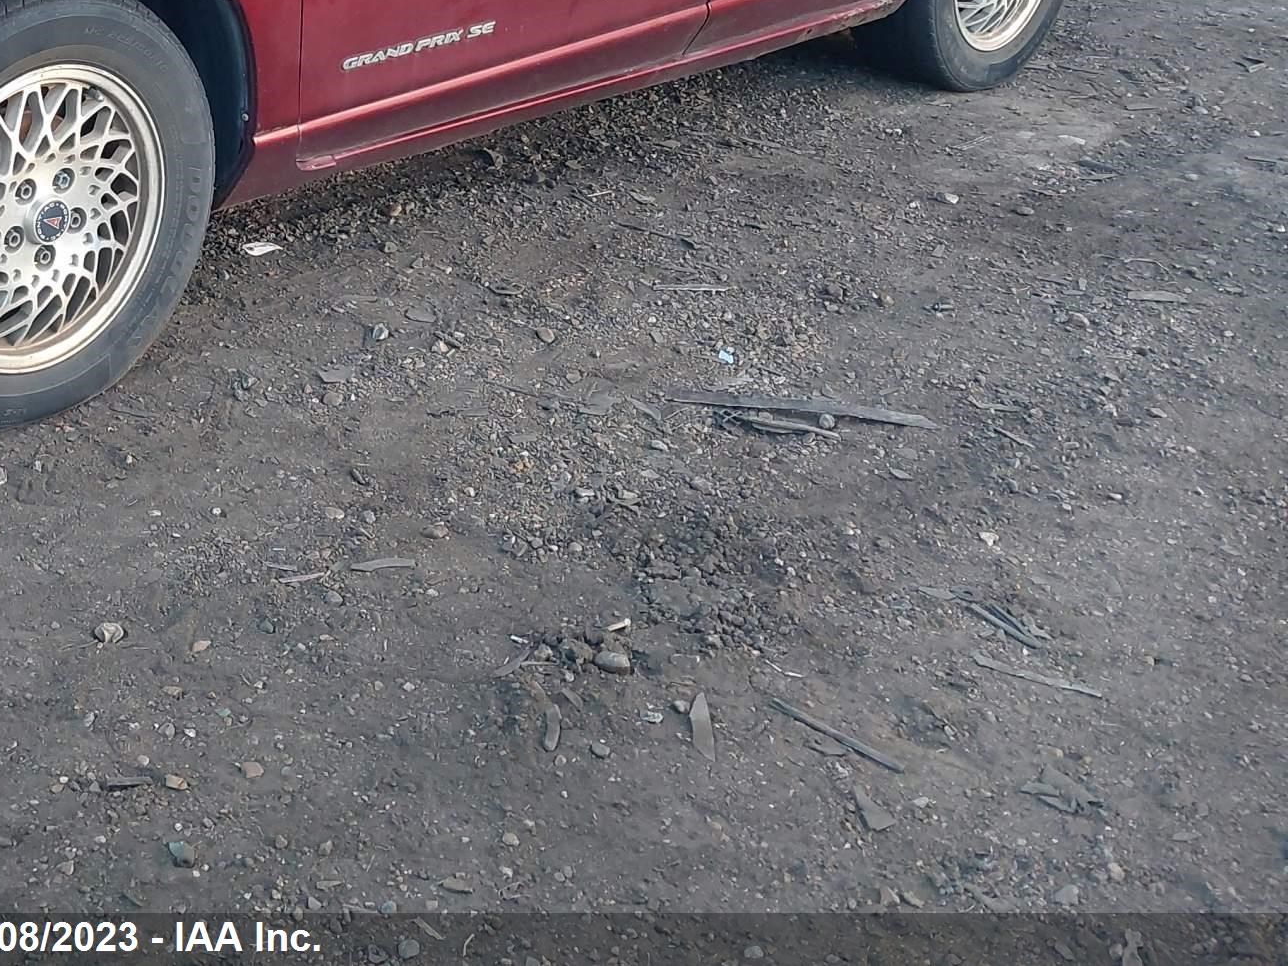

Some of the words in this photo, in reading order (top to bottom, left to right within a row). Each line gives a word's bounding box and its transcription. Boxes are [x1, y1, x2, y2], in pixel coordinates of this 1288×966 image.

[342, 42, 413, 71] GRAND
[415, 28, 464, 52] PRIX
[467, 20, 496, 38] SE
